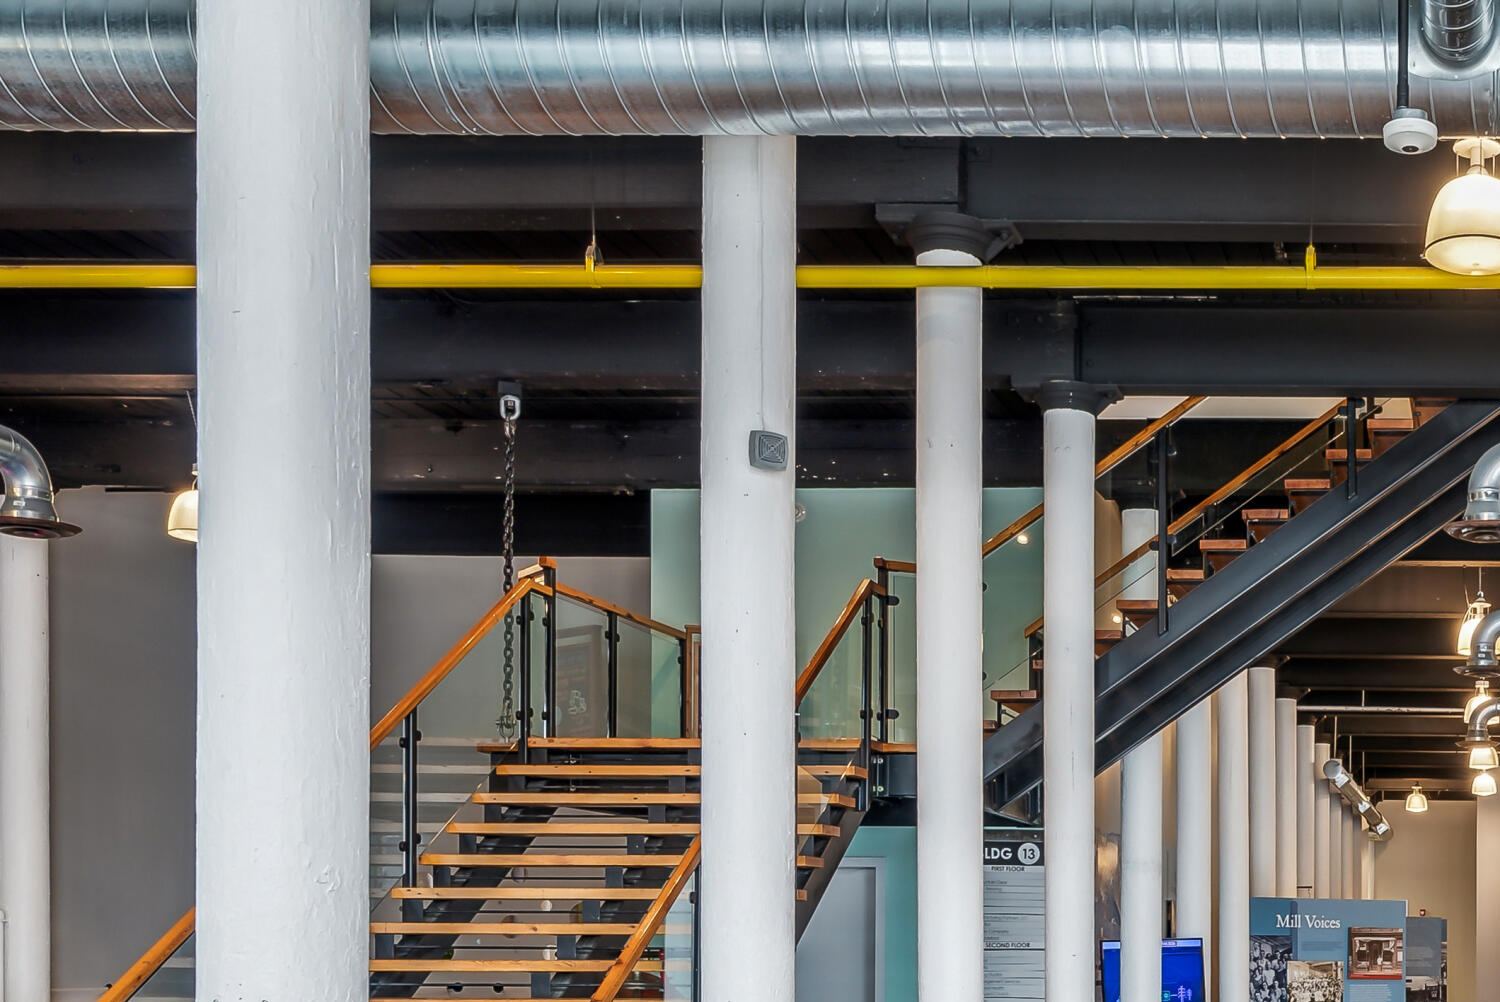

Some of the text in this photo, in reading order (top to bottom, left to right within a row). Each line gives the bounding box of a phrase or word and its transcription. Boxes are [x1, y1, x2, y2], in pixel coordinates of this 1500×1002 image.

[983, 847, 1036, 860] LDG 13
[1275, 914, 1341, 929] Mill Voices
